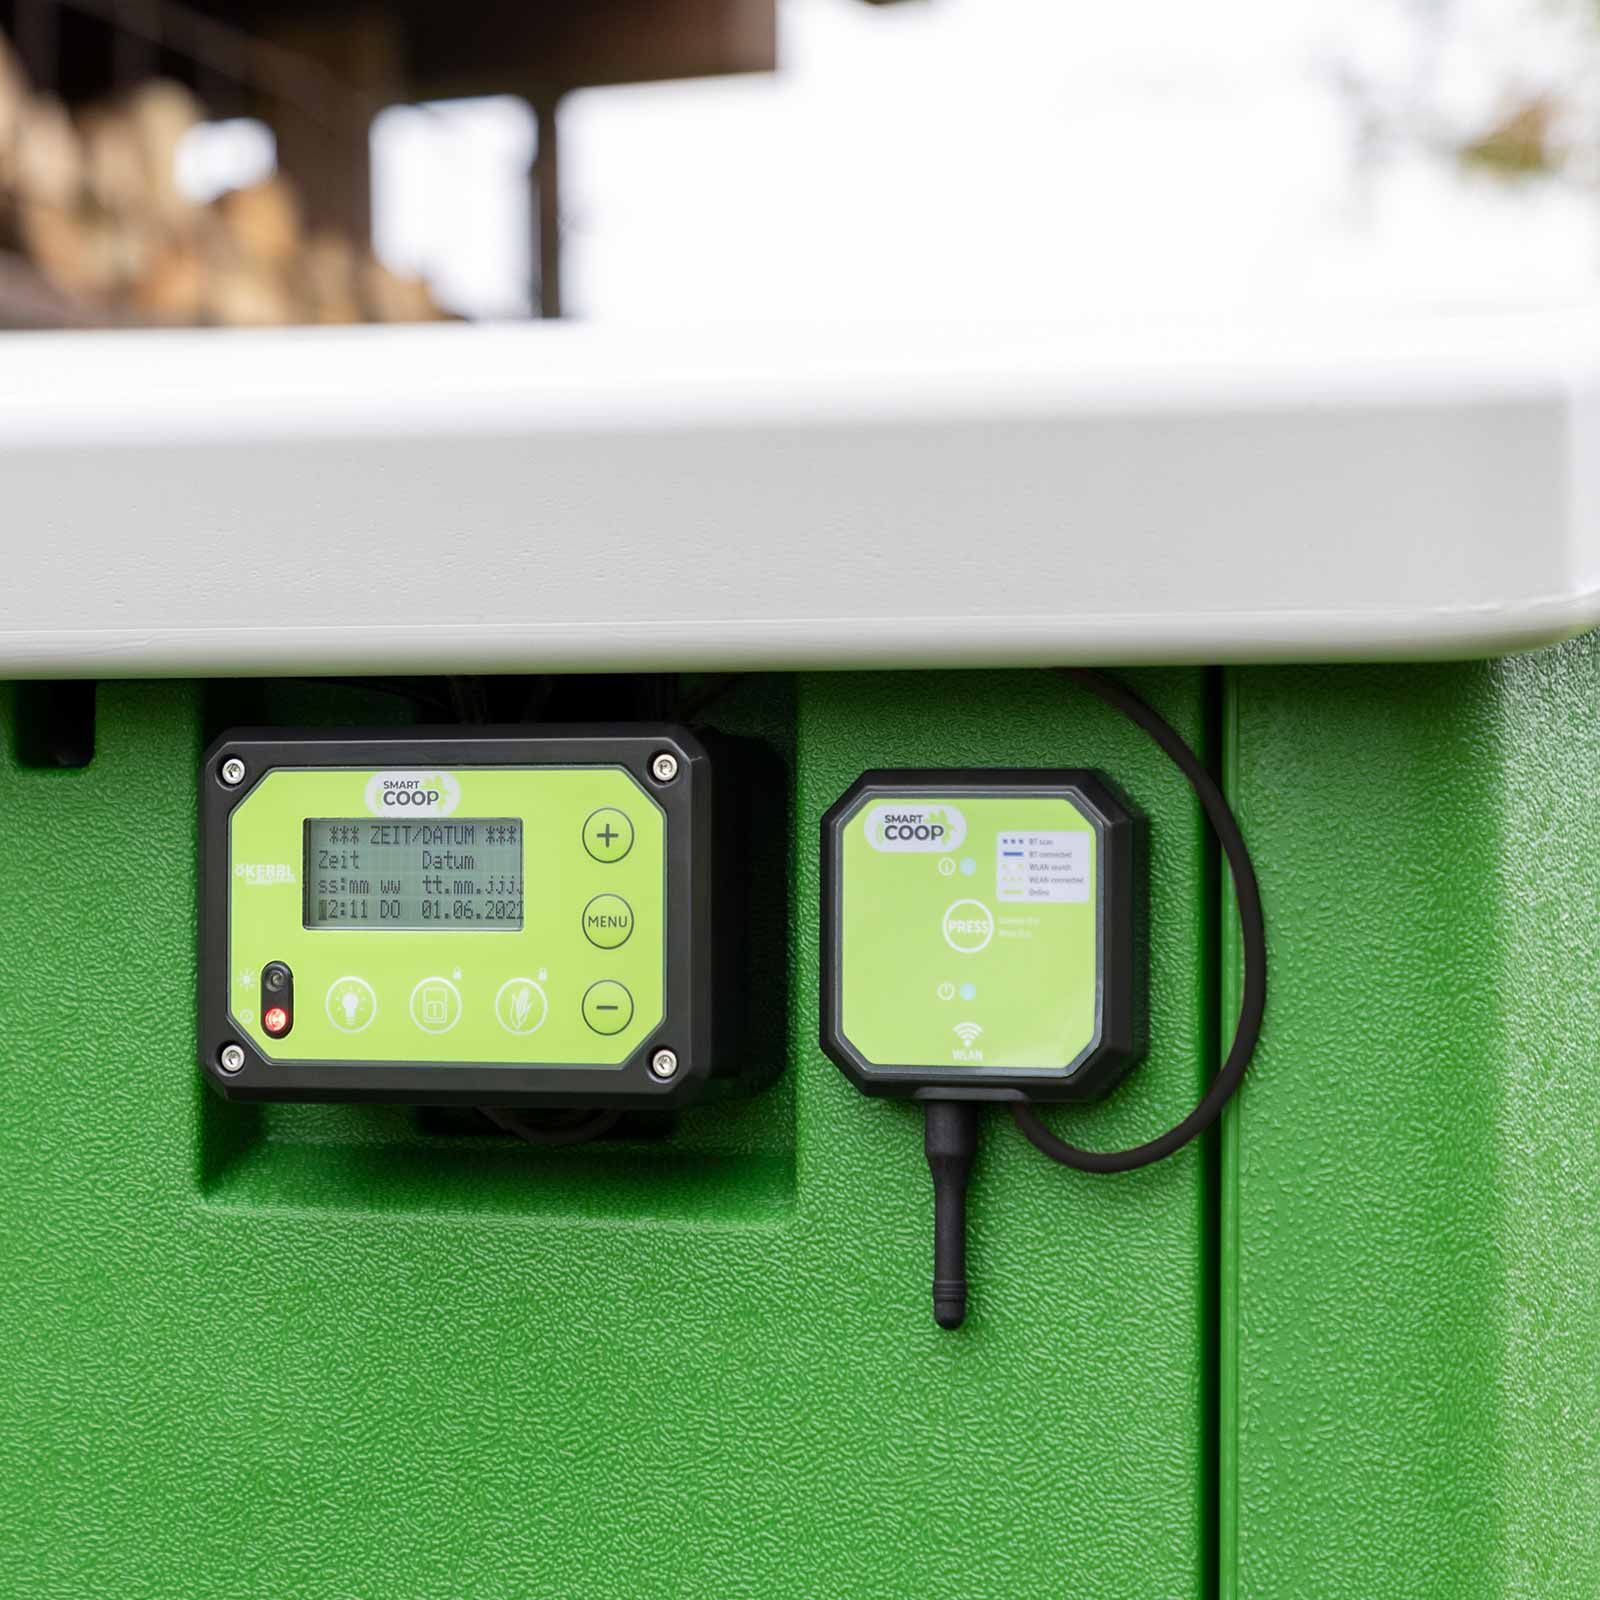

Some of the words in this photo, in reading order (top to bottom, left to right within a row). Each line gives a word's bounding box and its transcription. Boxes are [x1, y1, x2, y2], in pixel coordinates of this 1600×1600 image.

[383, 780, 420, 790] SMART
[383, 790, 439, 806] COOP
[884, 814, 924, 824] SMART
[370, 825, 475, 845] ZEIT/DATUM
[884, 825, 944, 841] COOP
[318, 850, 360, 870] Zeit
[422, 850, 475, 870] Datum
[318, 876, 370, 895] ss:mm
[380, 879, 401, 895] ww
[380, 899, 401, 919] DO
[588, 915, 628, 928] MENU
[949, 919, 989, 935] PRESS
[952, 1049, 984, 1061] WLAN
